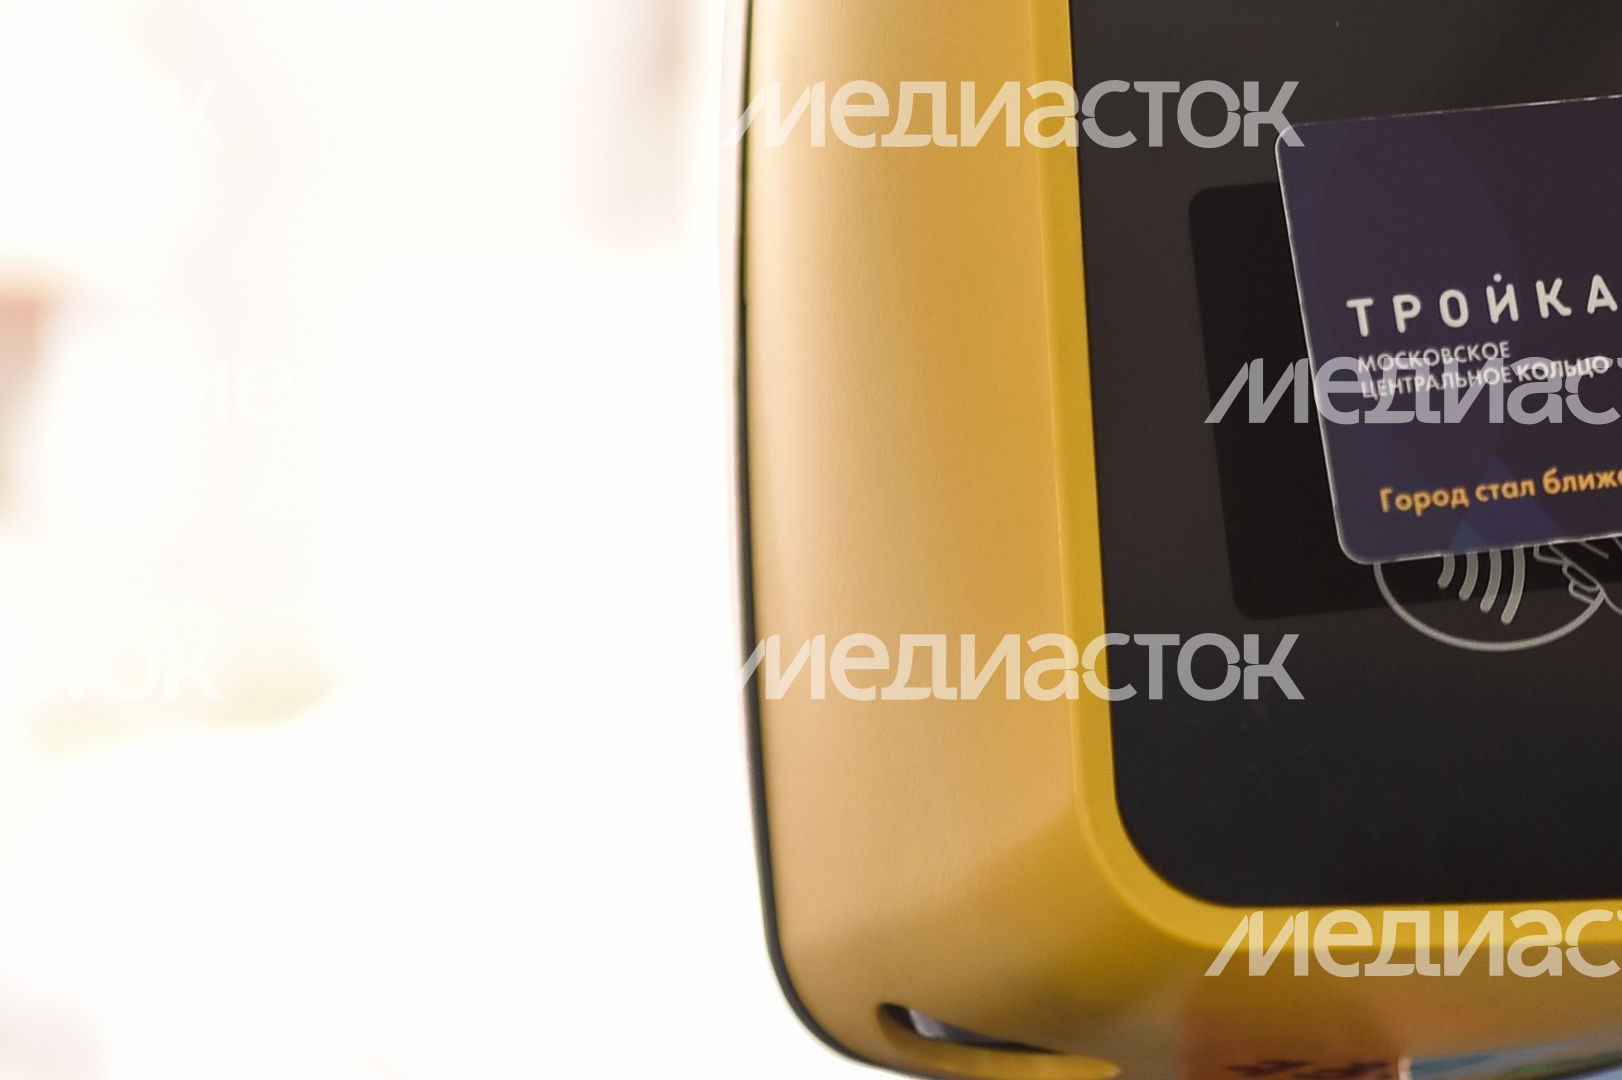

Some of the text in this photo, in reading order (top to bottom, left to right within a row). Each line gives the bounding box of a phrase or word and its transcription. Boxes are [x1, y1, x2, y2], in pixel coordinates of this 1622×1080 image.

[1346, 273, 1618, 337] ТРОЙКА
[1357, 340, 1512, 373] МОСКОВСКОЕ
[1360, 354, 1611, 400] ЦЕНТРАЛЬНОЕ КОЛЬЦО
[1379, 486, 1470, 517] Город
[1474, 479, 1536, 503] стал
